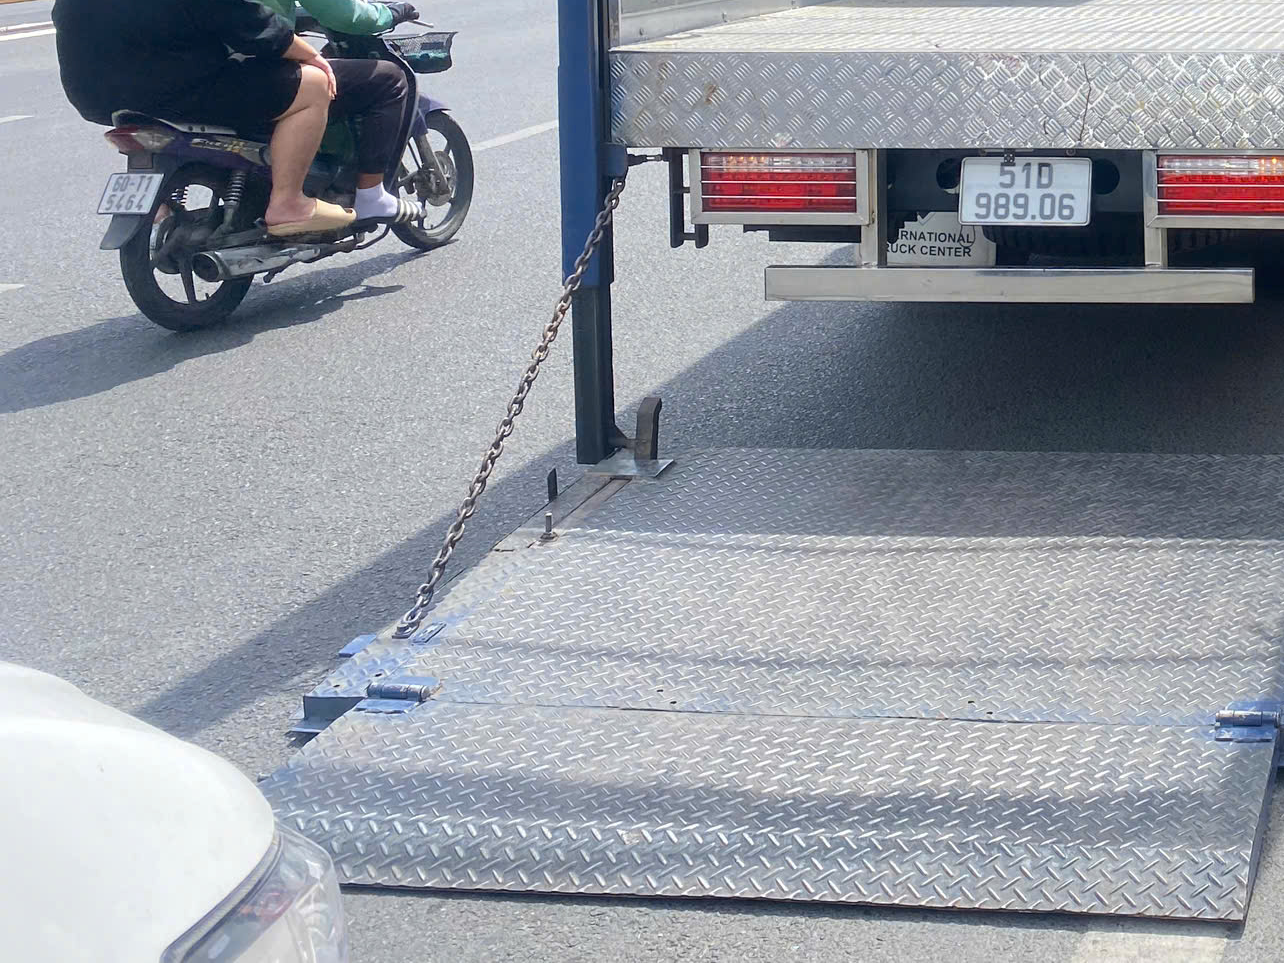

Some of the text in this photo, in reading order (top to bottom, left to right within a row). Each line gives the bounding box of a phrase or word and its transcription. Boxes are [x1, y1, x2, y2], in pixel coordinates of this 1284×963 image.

[113, 175, 154, 192] 60-T1
[999, 162, 1053, 189] 51D
[105, 194, 144, 211] 5464
[974, 192, 1075, 220] 989.06
[900, 230, 975, 244] RNATIONAL
[920, 245, 972, 258] CENTER
